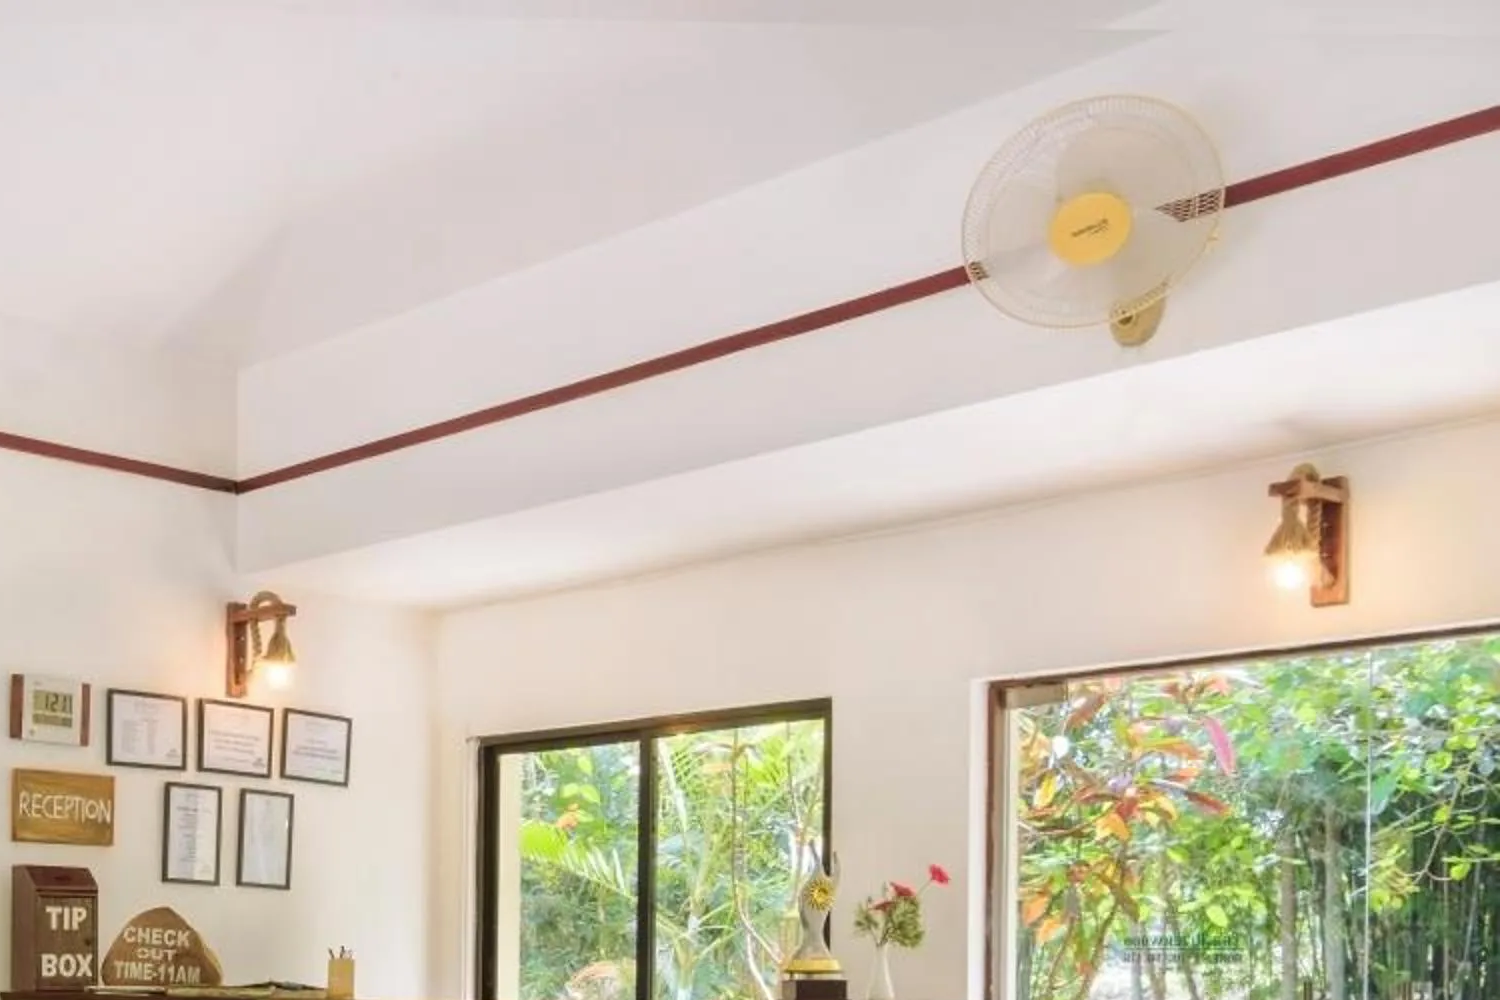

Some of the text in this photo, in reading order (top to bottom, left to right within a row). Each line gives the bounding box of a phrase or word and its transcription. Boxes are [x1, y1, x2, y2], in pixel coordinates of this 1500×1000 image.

[18, 790, 111, 824] RECEPTION
[45, 906, 87, 931] TIP
[123, 926, 191, 947] CHECK
[41, 953, 93, 977] BOX
[135, 948, 177, 961] OUT
